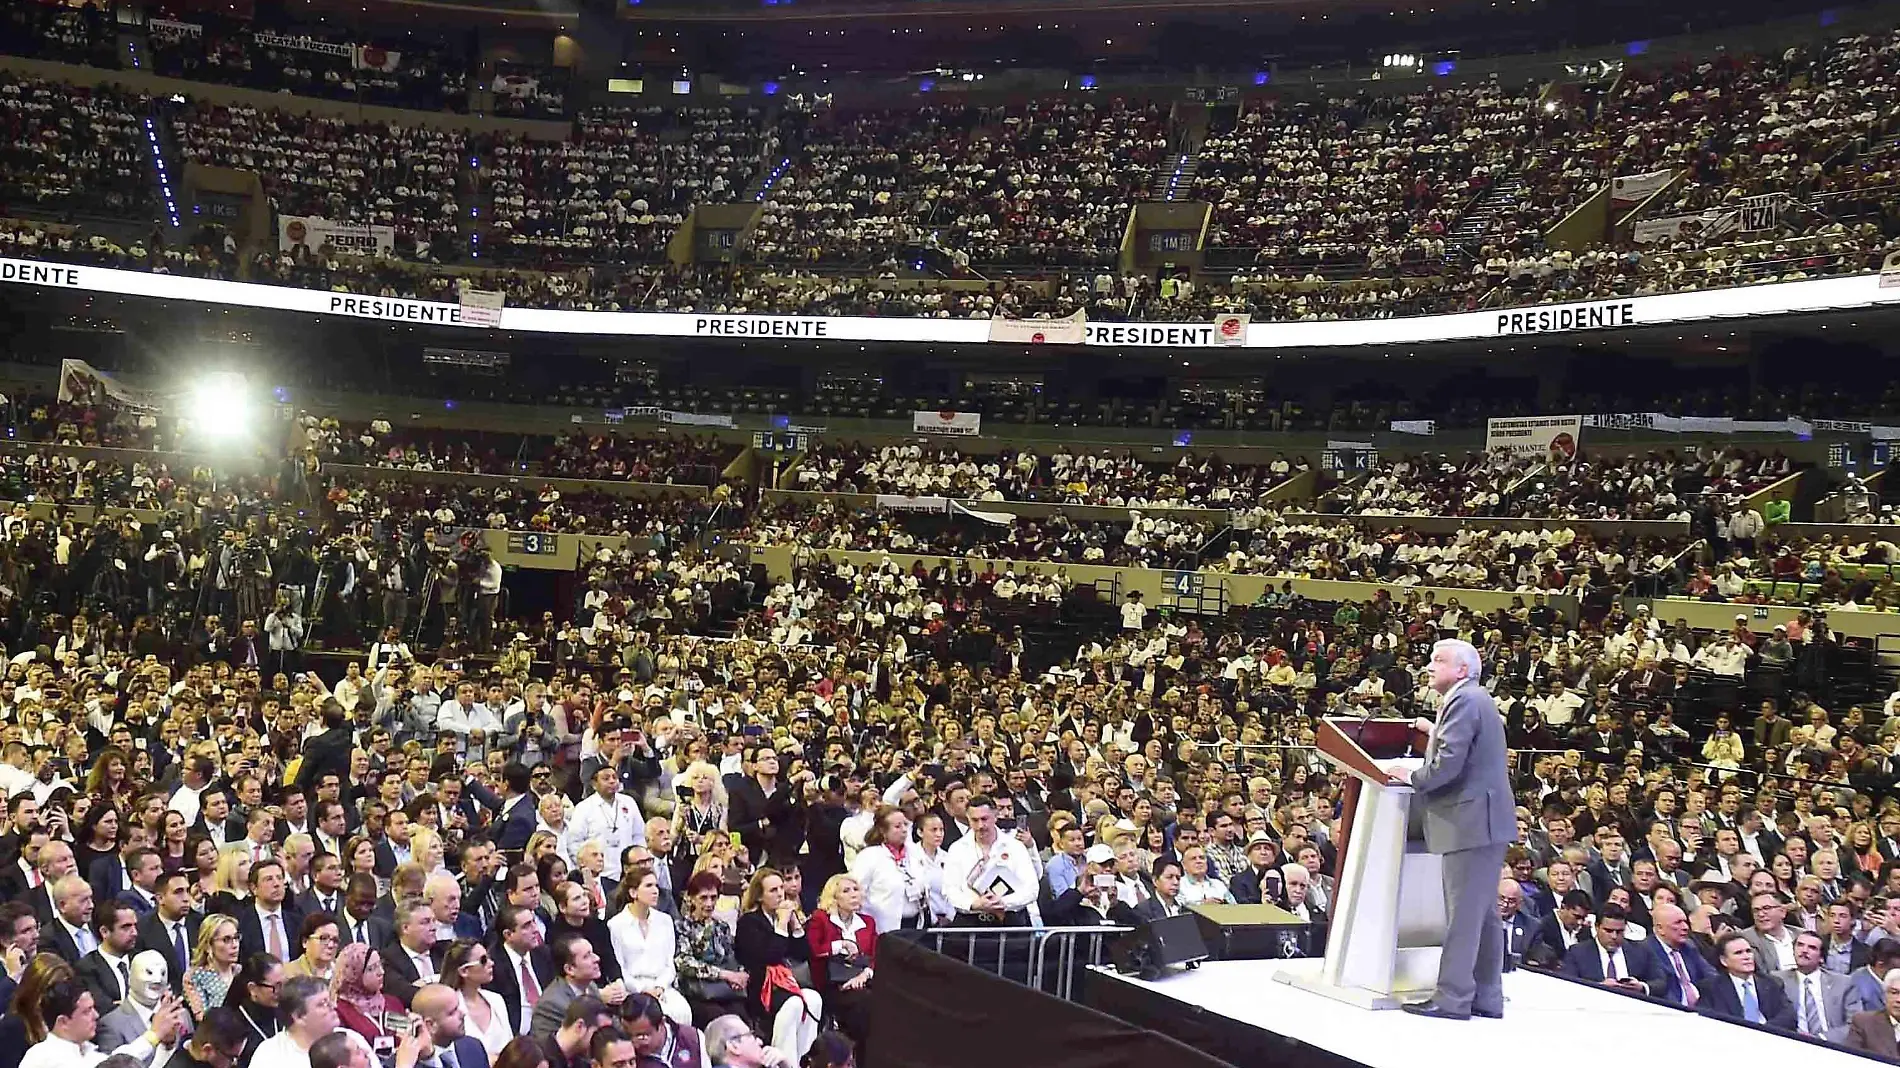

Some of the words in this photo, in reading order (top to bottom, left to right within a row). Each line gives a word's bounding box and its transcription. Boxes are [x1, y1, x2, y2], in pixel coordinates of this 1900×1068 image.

[330, 297, 460, 322] PRESIDENTE
[1498, 303, 1633, 334] PRESIDENTE
[696, 319, 827, 336] PRESIDENTE
[1334, 455, 1344, 468] K
[1356, 456, 1365, 468] K
[1846, 450, 1856, 465] L
[1873, 449, 1884, 465] L
[527, 535, 538, 552] 3
[1178, 575, 1189, 594] 4
